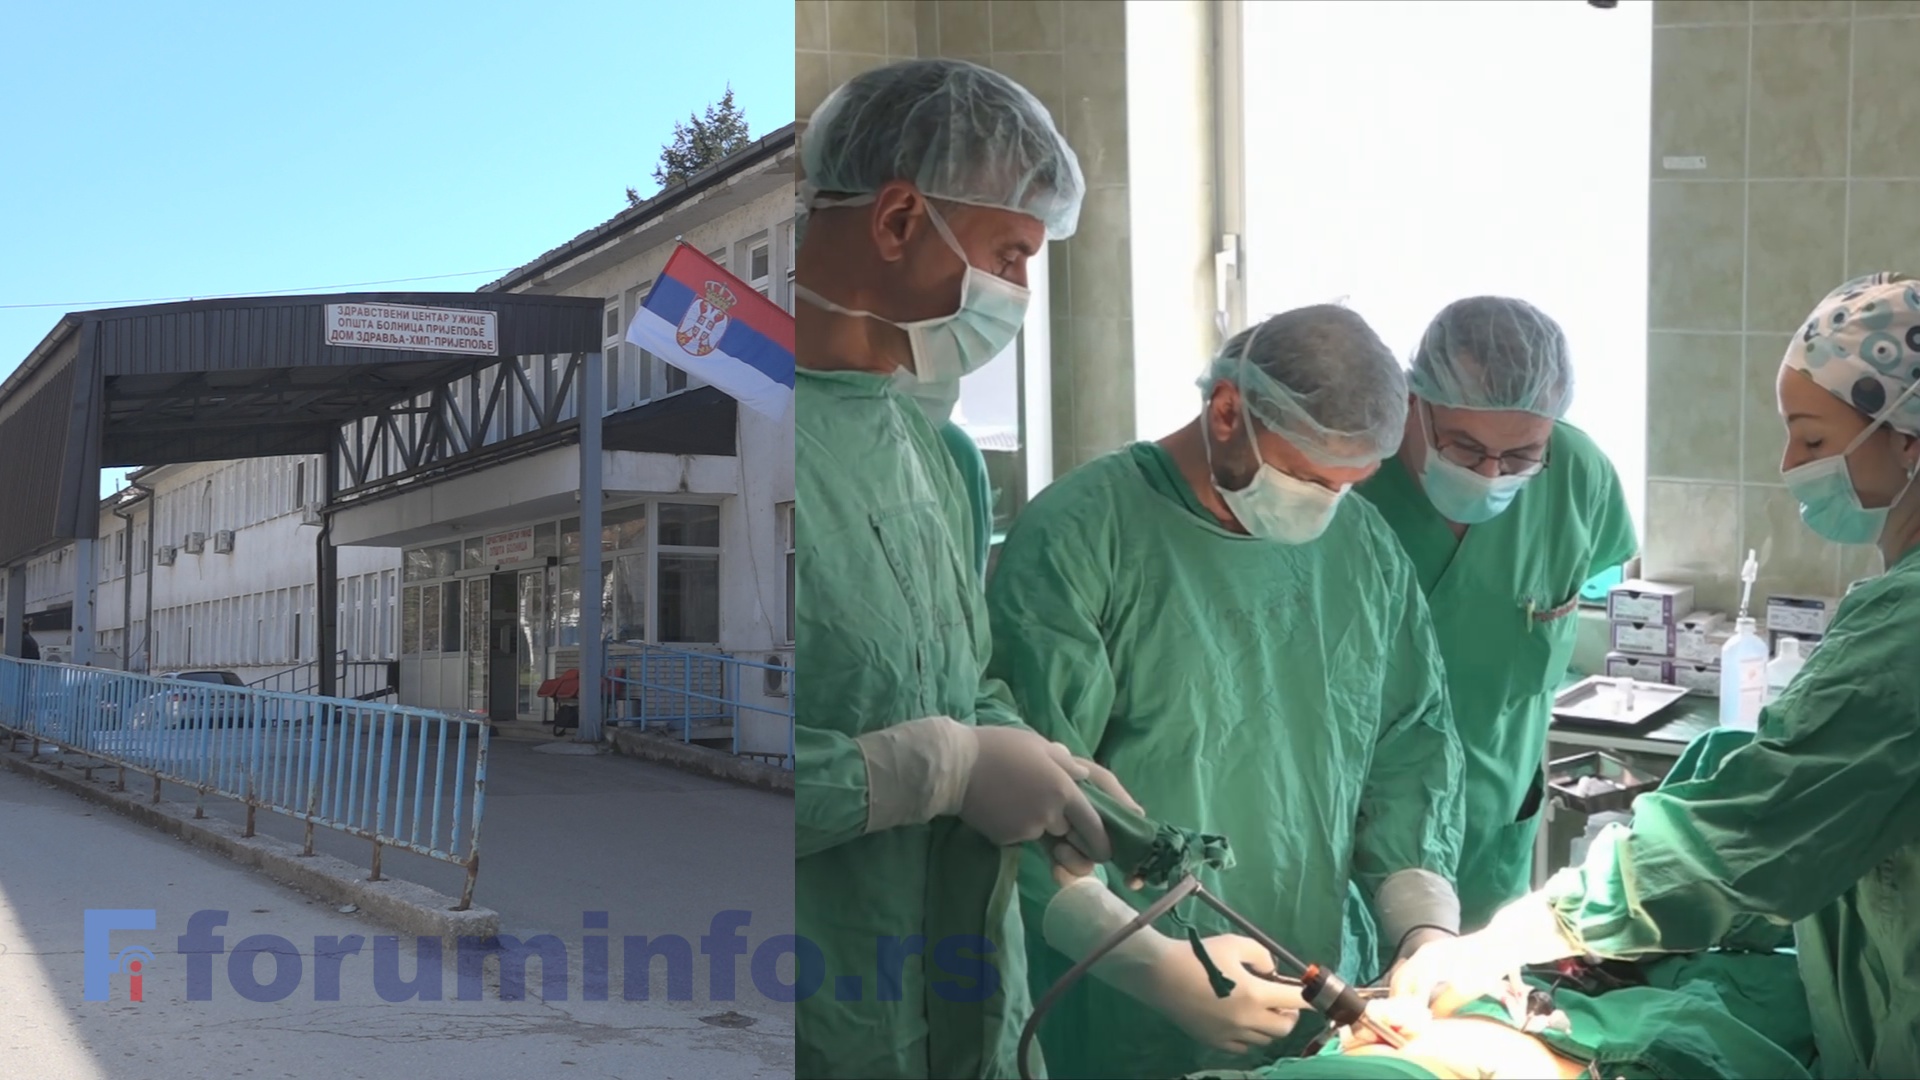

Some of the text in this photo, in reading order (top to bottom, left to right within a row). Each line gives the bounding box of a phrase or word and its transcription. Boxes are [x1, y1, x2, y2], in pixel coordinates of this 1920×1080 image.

[337, 305, 486, 326] ЗДРАВСТВЕНИ ЦЕНТАР УЖИЦЕ
[331, 329, 354, 341] ДОМ
[338, 317, 485, 337] ОПШТА БОЛНИЦА ПРИЈЕПОЉЕ
